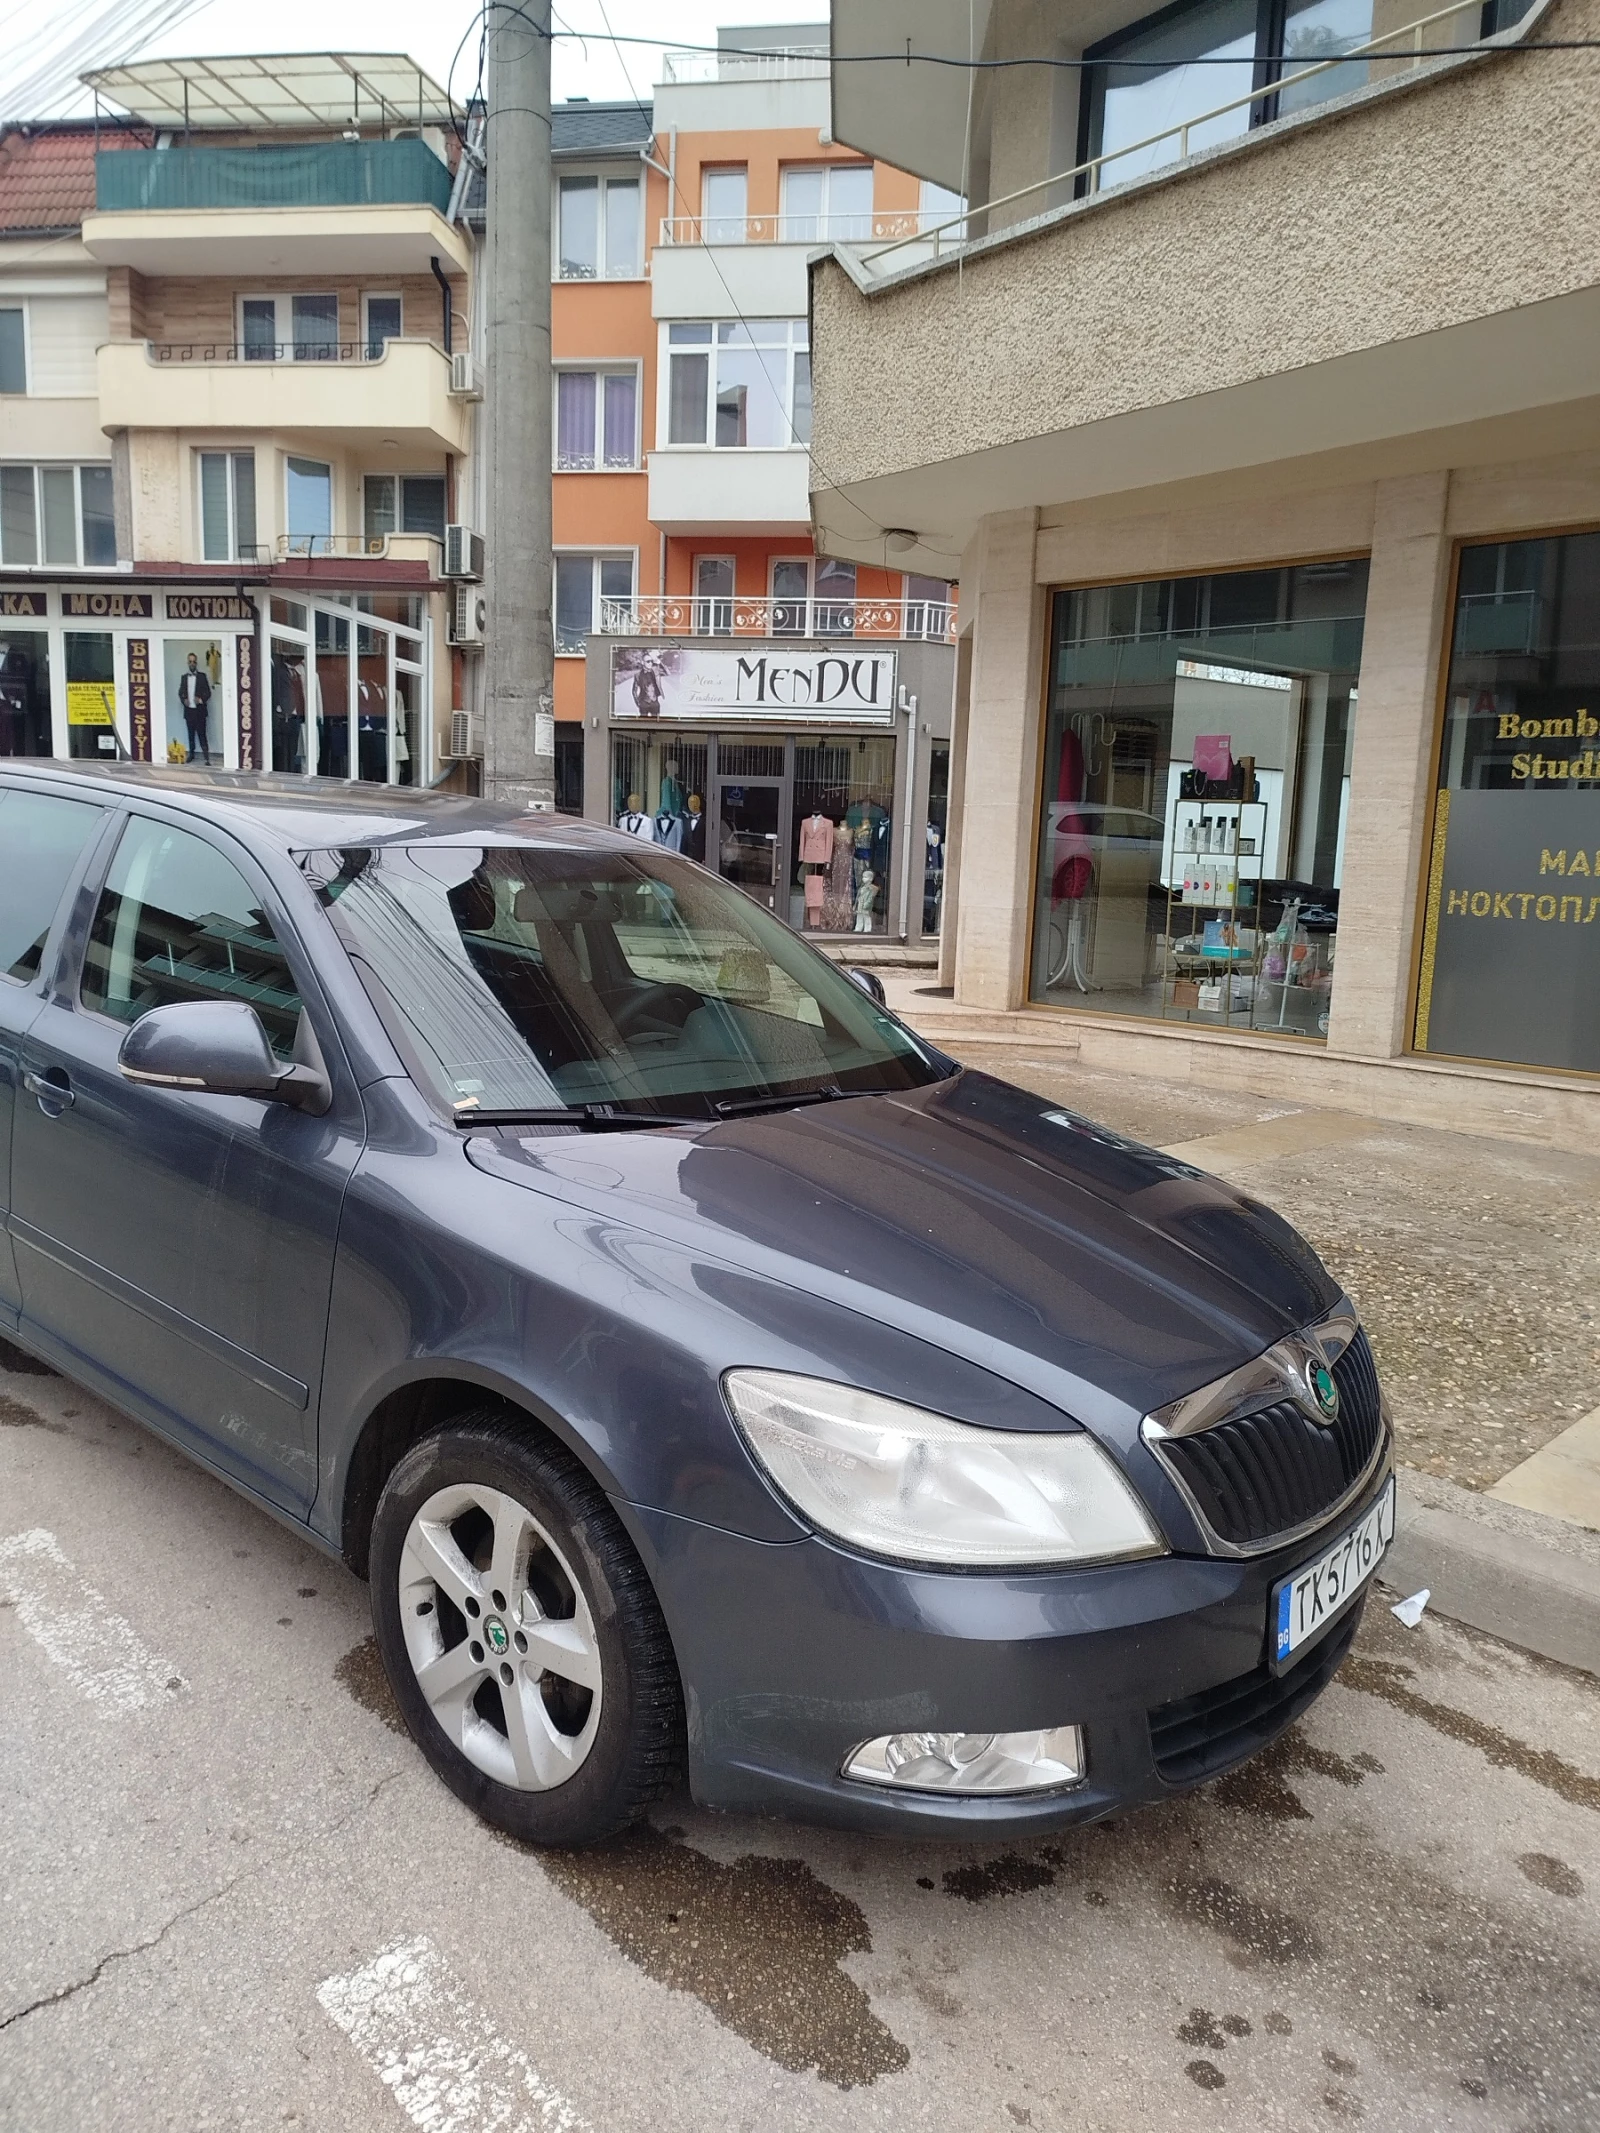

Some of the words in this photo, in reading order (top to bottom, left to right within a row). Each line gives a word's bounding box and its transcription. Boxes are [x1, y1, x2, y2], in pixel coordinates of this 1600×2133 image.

[0, 594, 35, 615] КА
[71, 594, 145, 617] МОДА
[130, 642, 149, 710] Bamze
[240, 637, 252, 689] 0876
[682, 688, 725, 703] Fashion
[241, 691, 252, 730] 666
[1496, 708, 1600, 739] Bomb
[1277, 1630, 1289, 1650] BG
